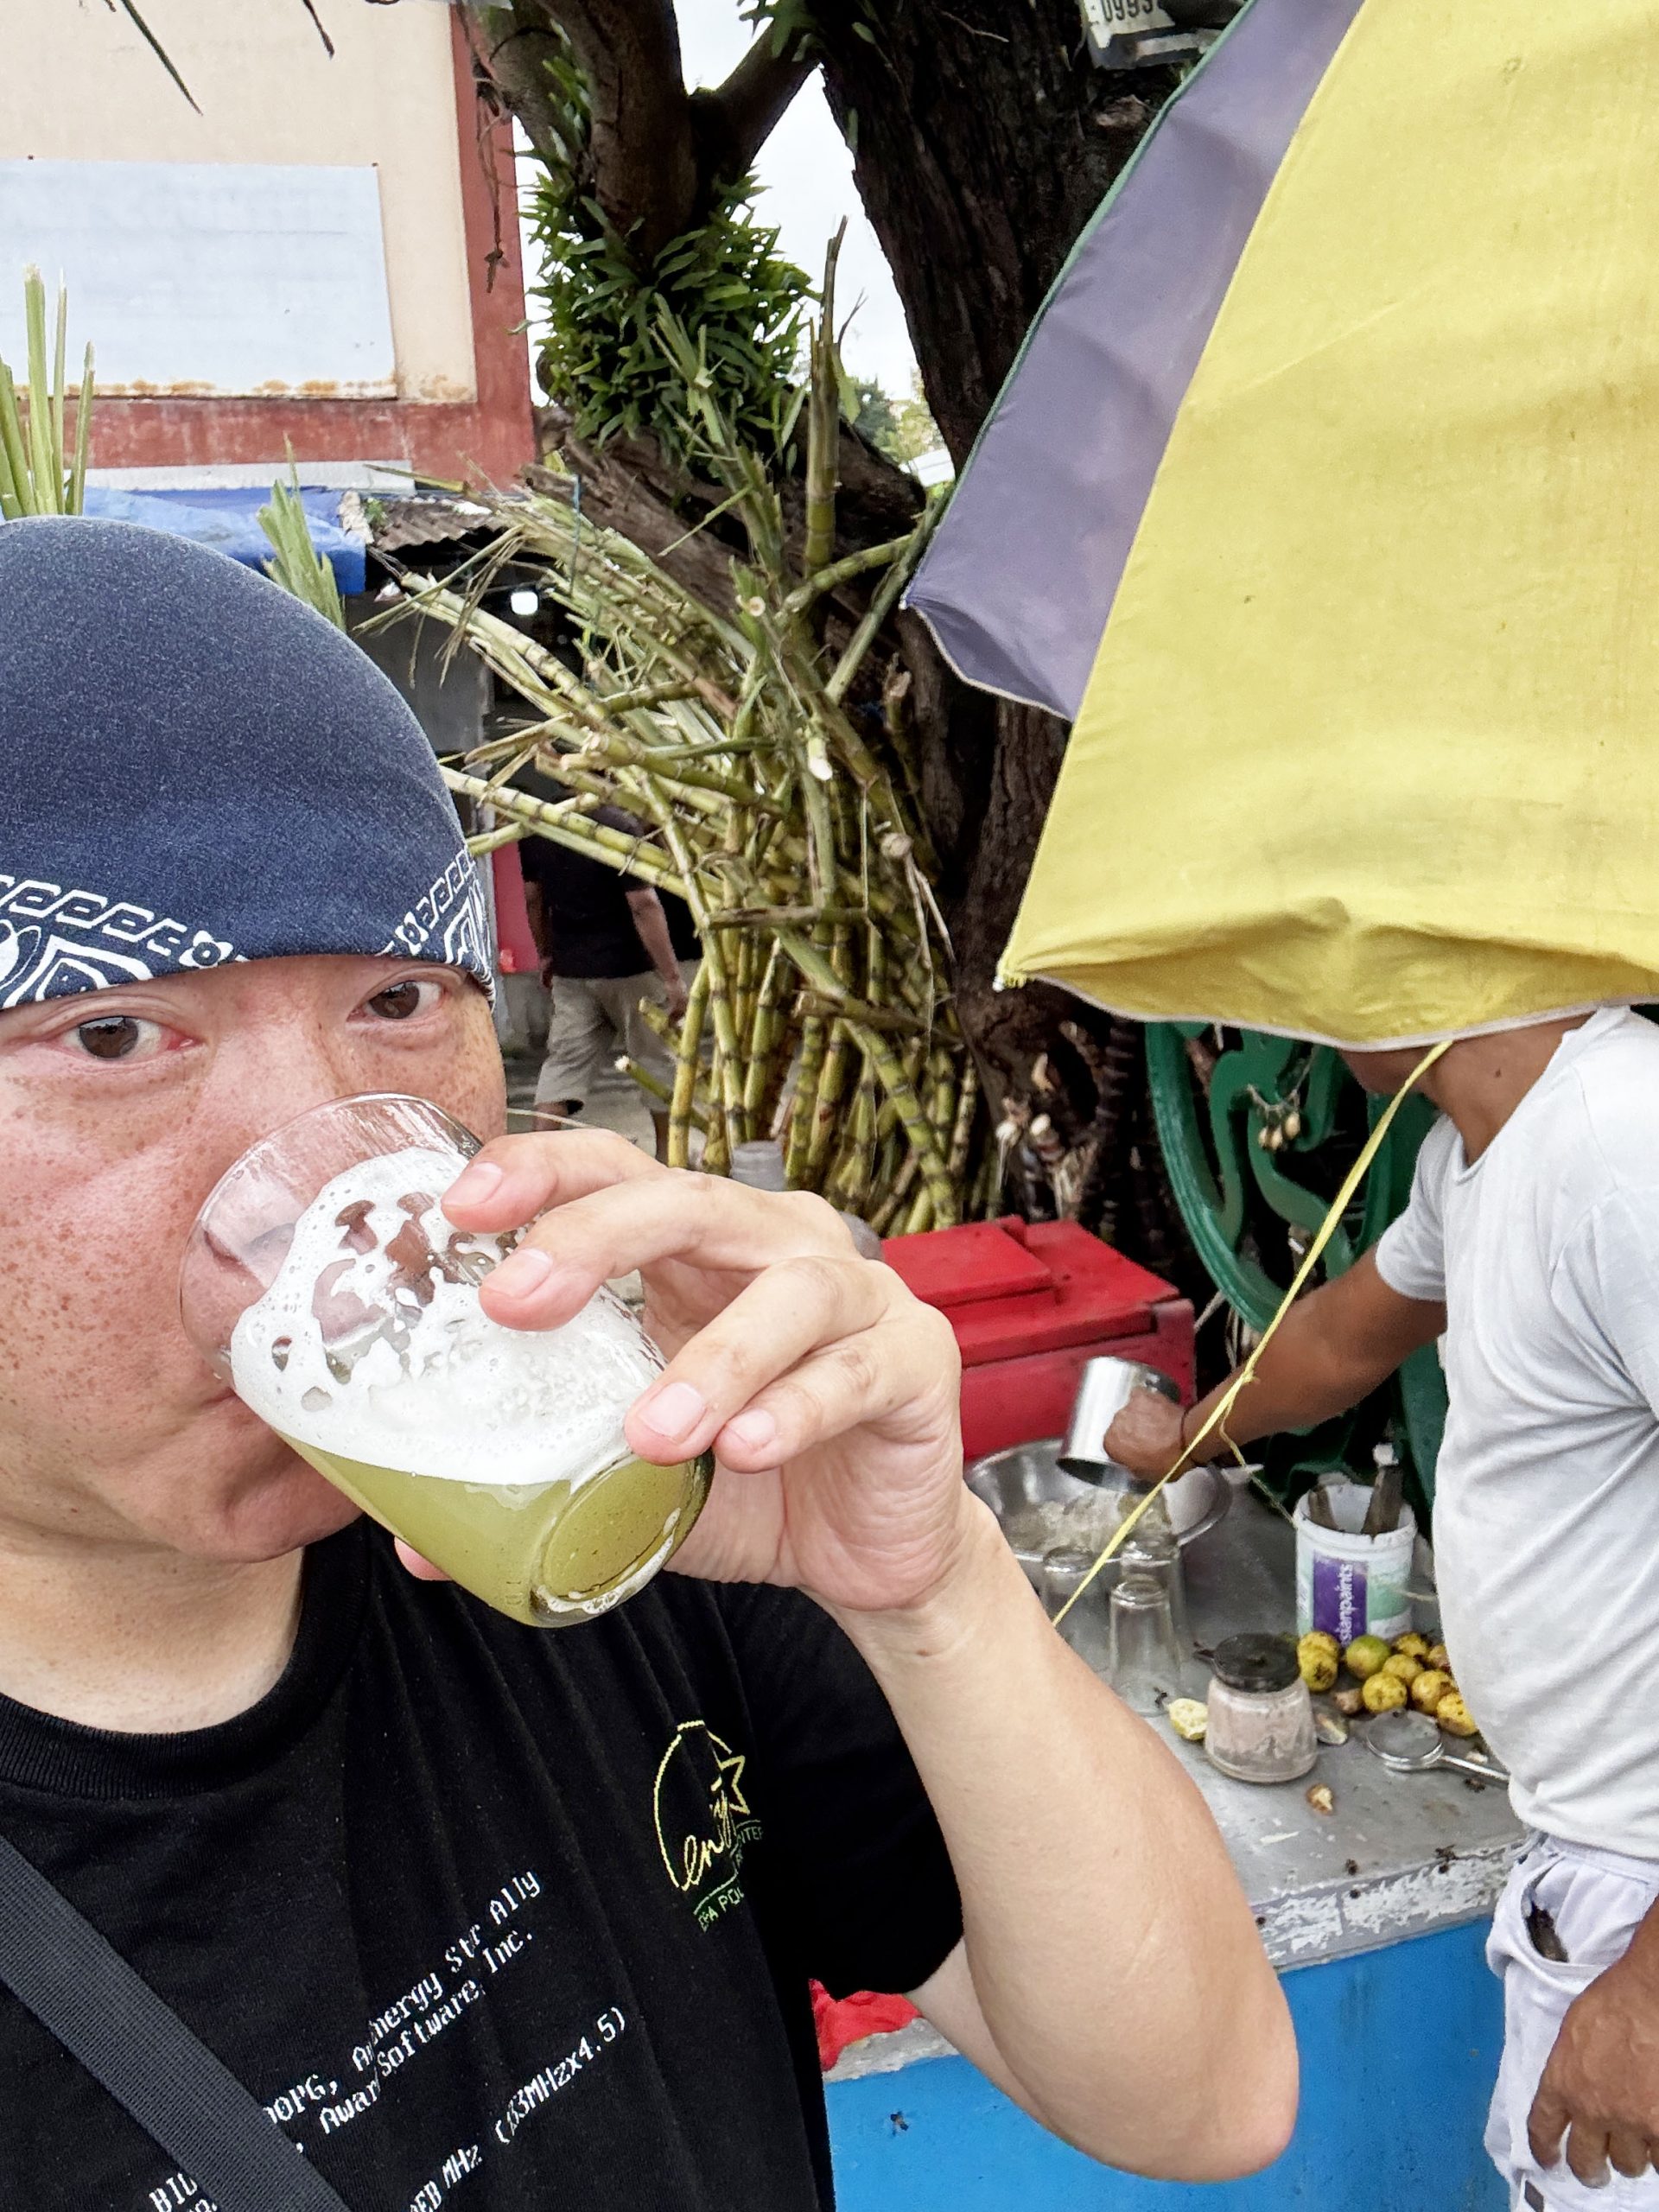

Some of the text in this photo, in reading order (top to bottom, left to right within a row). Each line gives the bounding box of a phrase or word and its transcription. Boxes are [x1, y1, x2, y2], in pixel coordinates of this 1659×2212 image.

[444, 1923, 481, 1974] Str
[488, 1871, 541, 1925] Ally
[482, 1929, 533, 1974] Inc.
[441, 2144, 483, 2190] MHz
